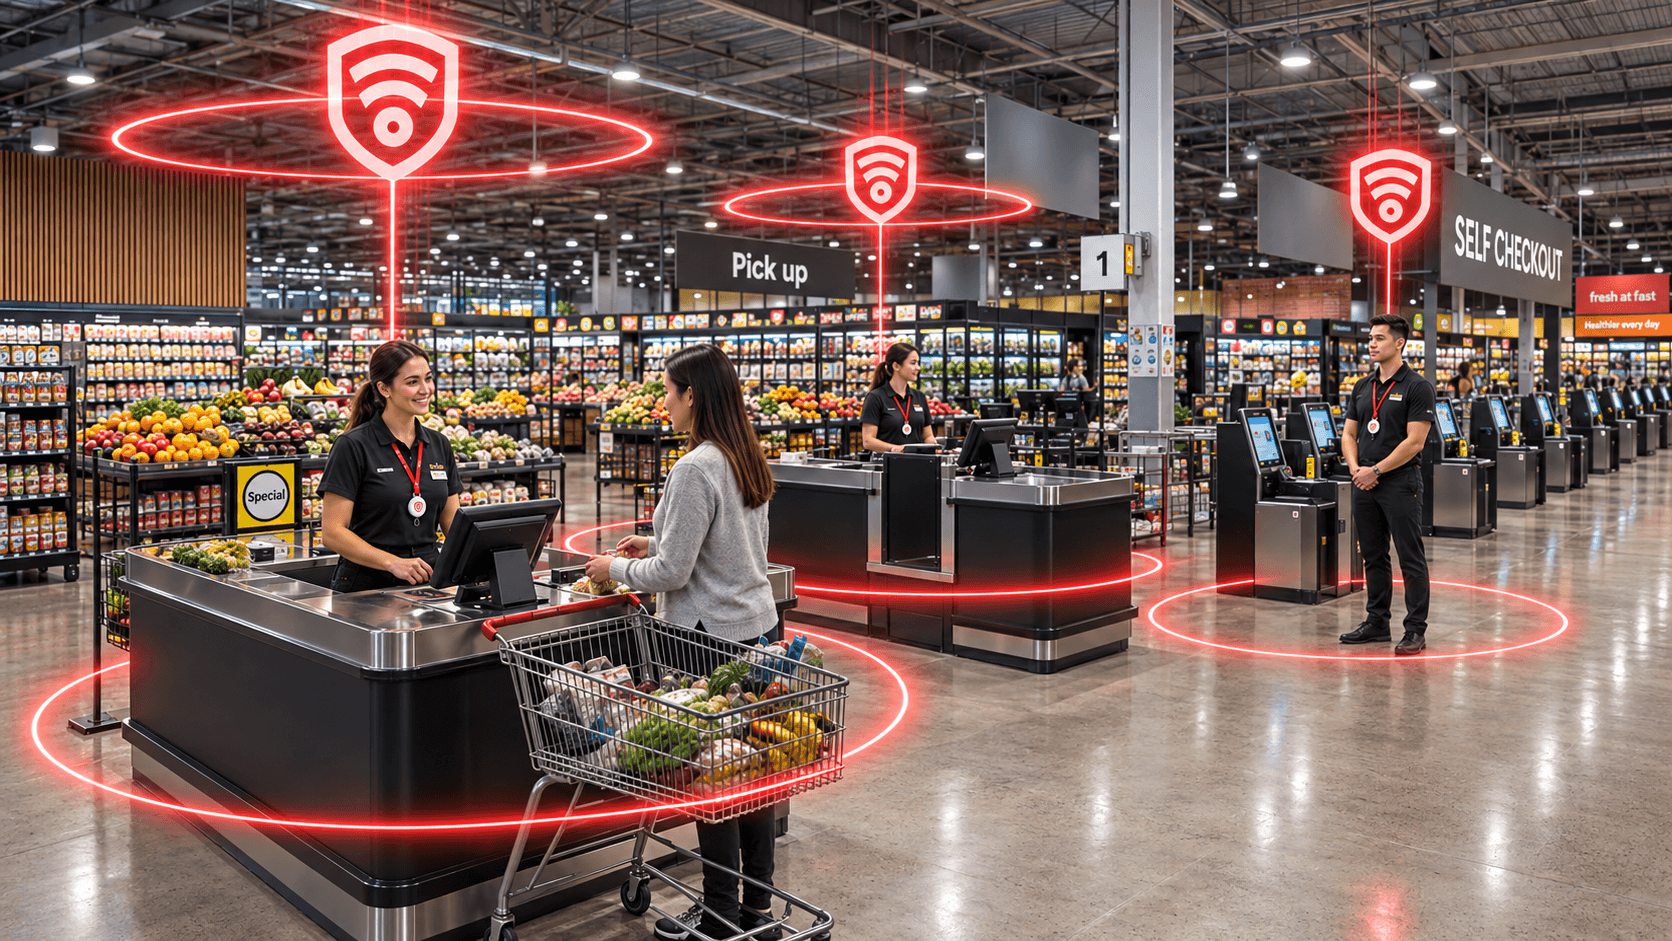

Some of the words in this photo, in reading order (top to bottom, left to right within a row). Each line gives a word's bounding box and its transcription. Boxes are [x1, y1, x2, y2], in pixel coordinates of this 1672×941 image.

[1454, 214, 1492, 263] SELF
[1494, 228, 1563, 281] CHECKOUT
[732, 251, 777, 280] Pick
[782, 263, 808, 289] up
[1096, 251, 1107, 276] 1
[1589, 290, 1618, 303] fresh
[1620, 291, 1632, 302] at
[1634, 289, 1657, 302] fast
[1621, 321, 1643, 330] every
[1644, 319, 1660, 330] day
[247, 488, 286, 505] Special
